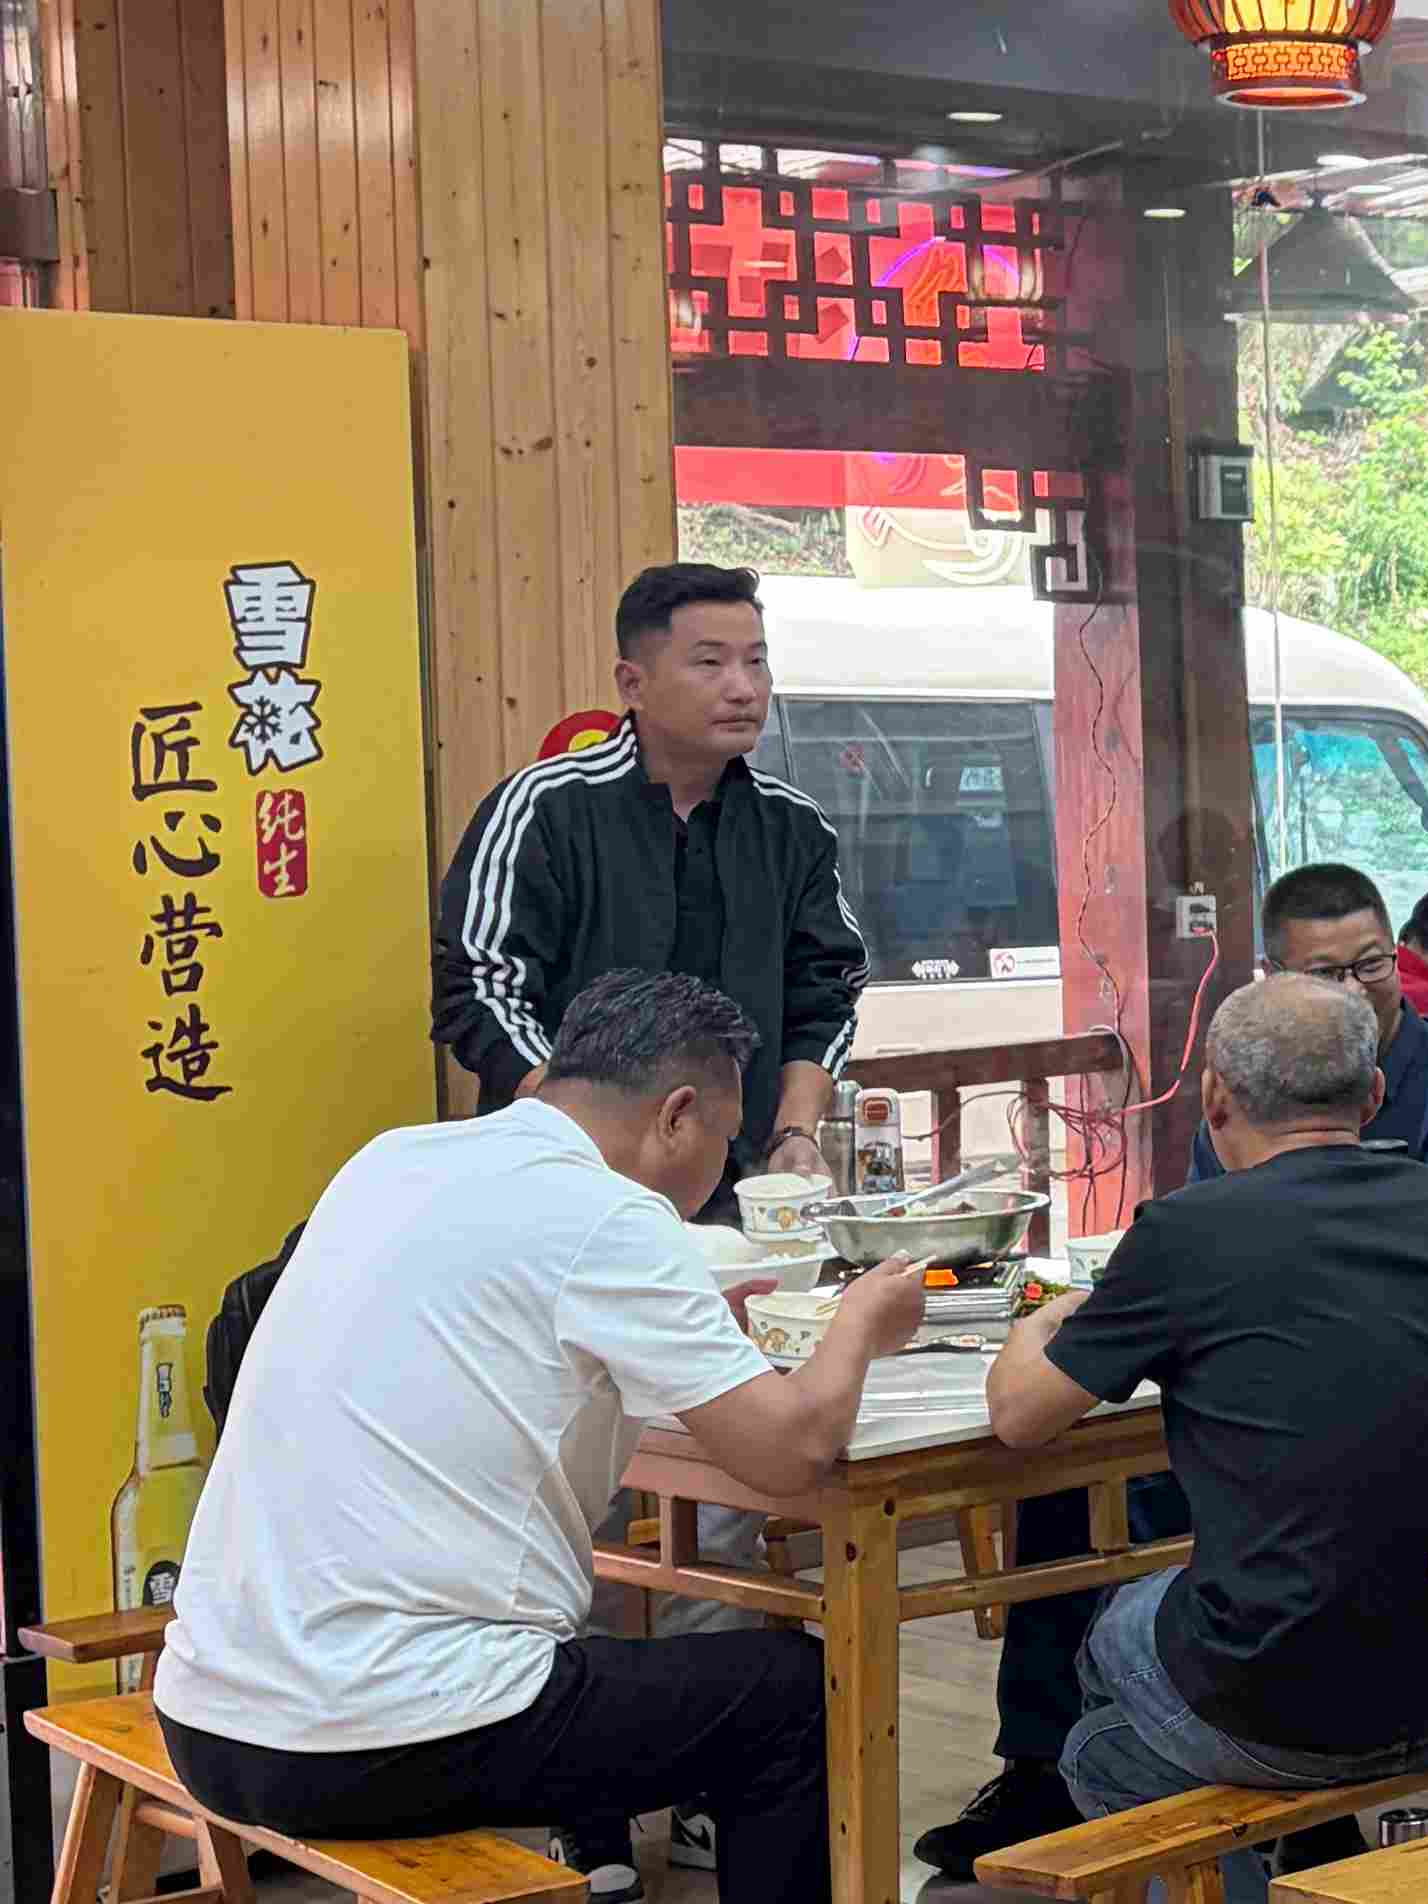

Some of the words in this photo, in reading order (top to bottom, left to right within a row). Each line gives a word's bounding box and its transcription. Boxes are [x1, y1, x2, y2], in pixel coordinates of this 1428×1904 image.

[224, 561, 323, 776] 雪花
[131, 701, 233, 1101] 匠心营造
[258, 792, 305, 896] 纯生
